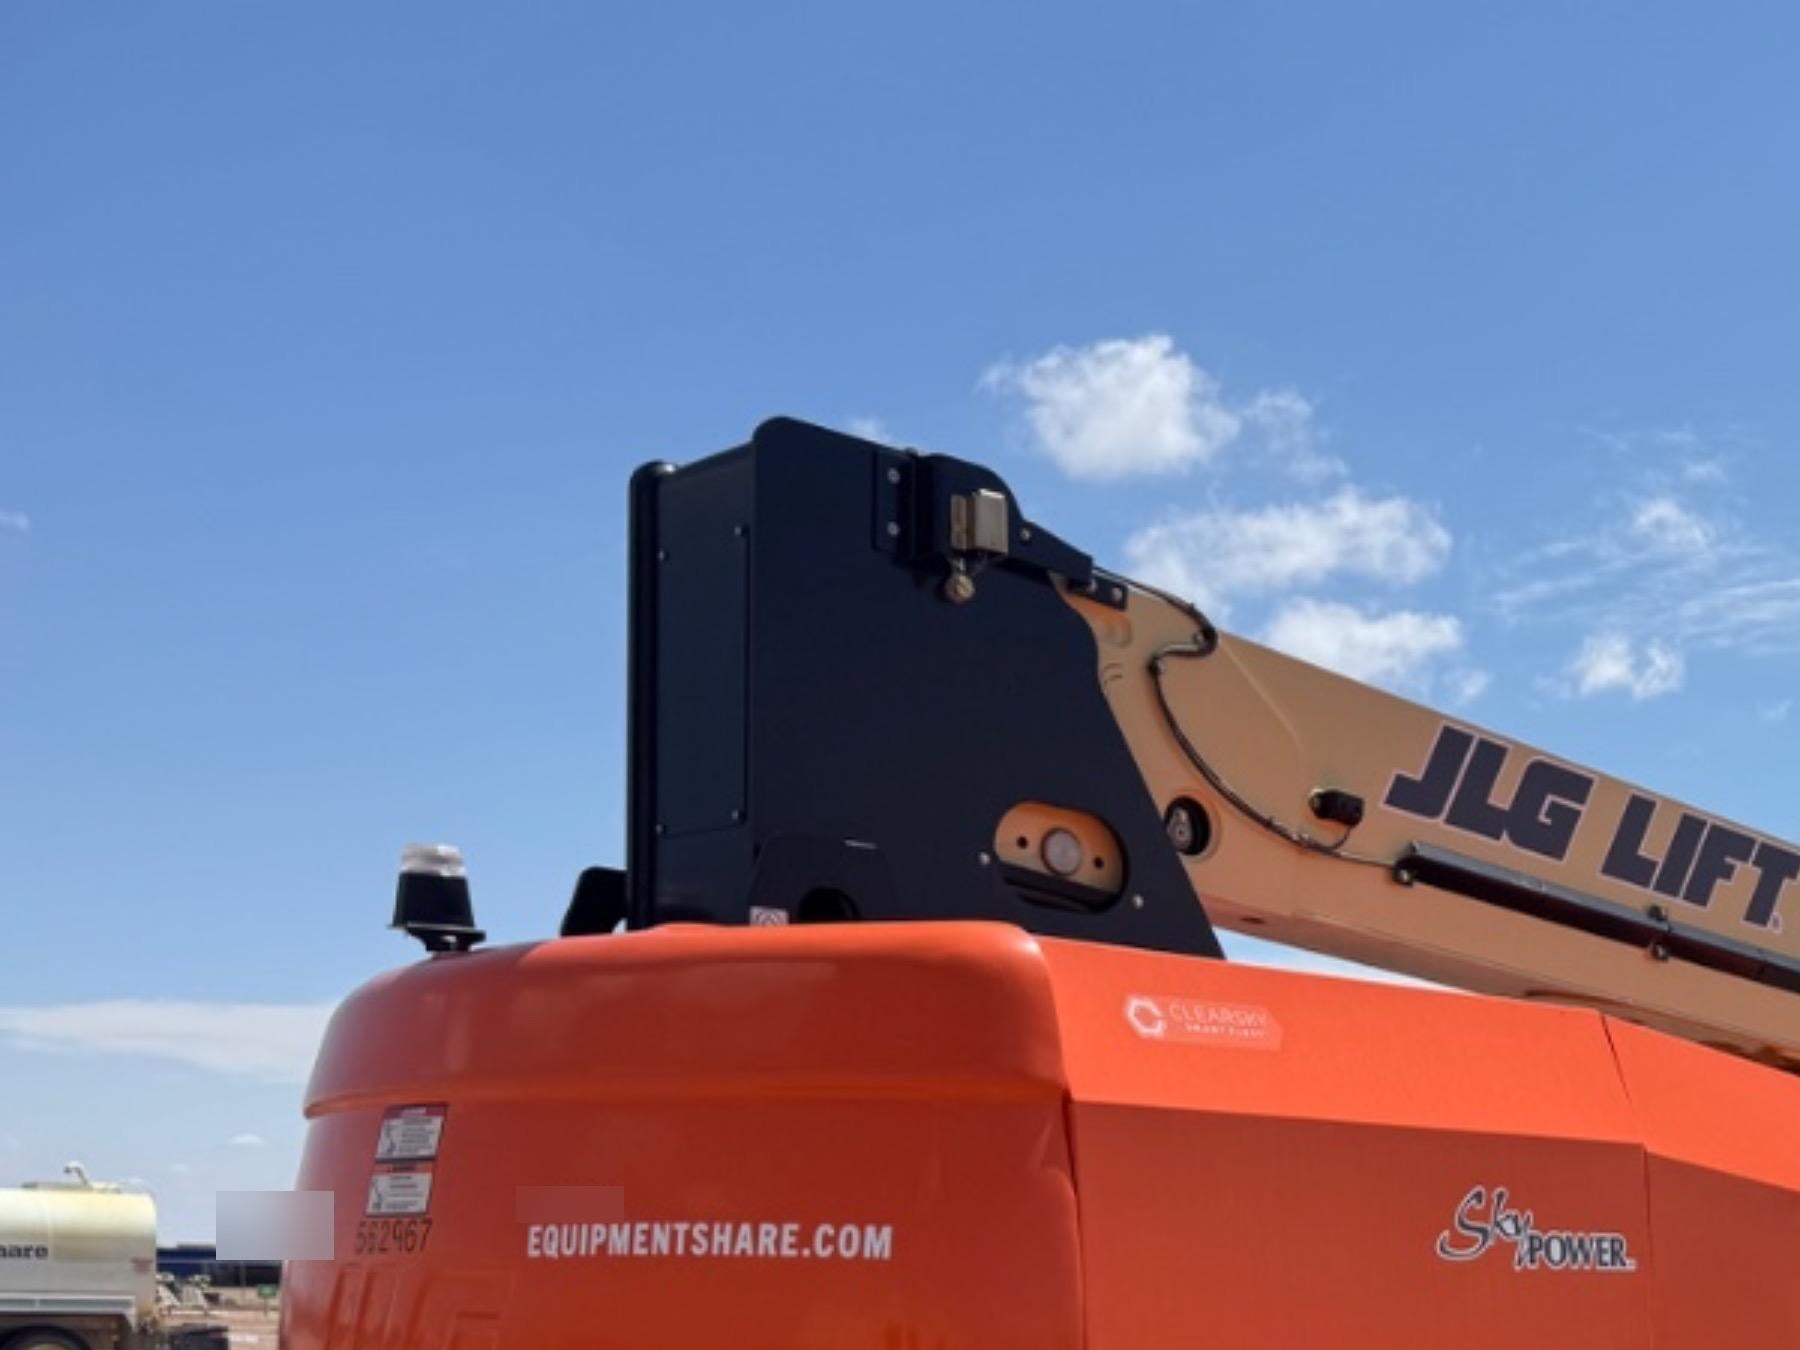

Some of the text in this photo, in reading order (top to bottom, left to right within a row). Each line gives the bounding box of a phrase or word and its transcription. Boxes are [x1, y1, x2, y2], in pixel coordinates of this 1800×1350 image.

[1380, 721, 1597, 863] JLG
[354, 1218, 433, 1255] 562967
[527, 1222, 893, 1260] EQUIPMENTSHARE.COM
[1527, 1231, 1628, 1269] POWER
